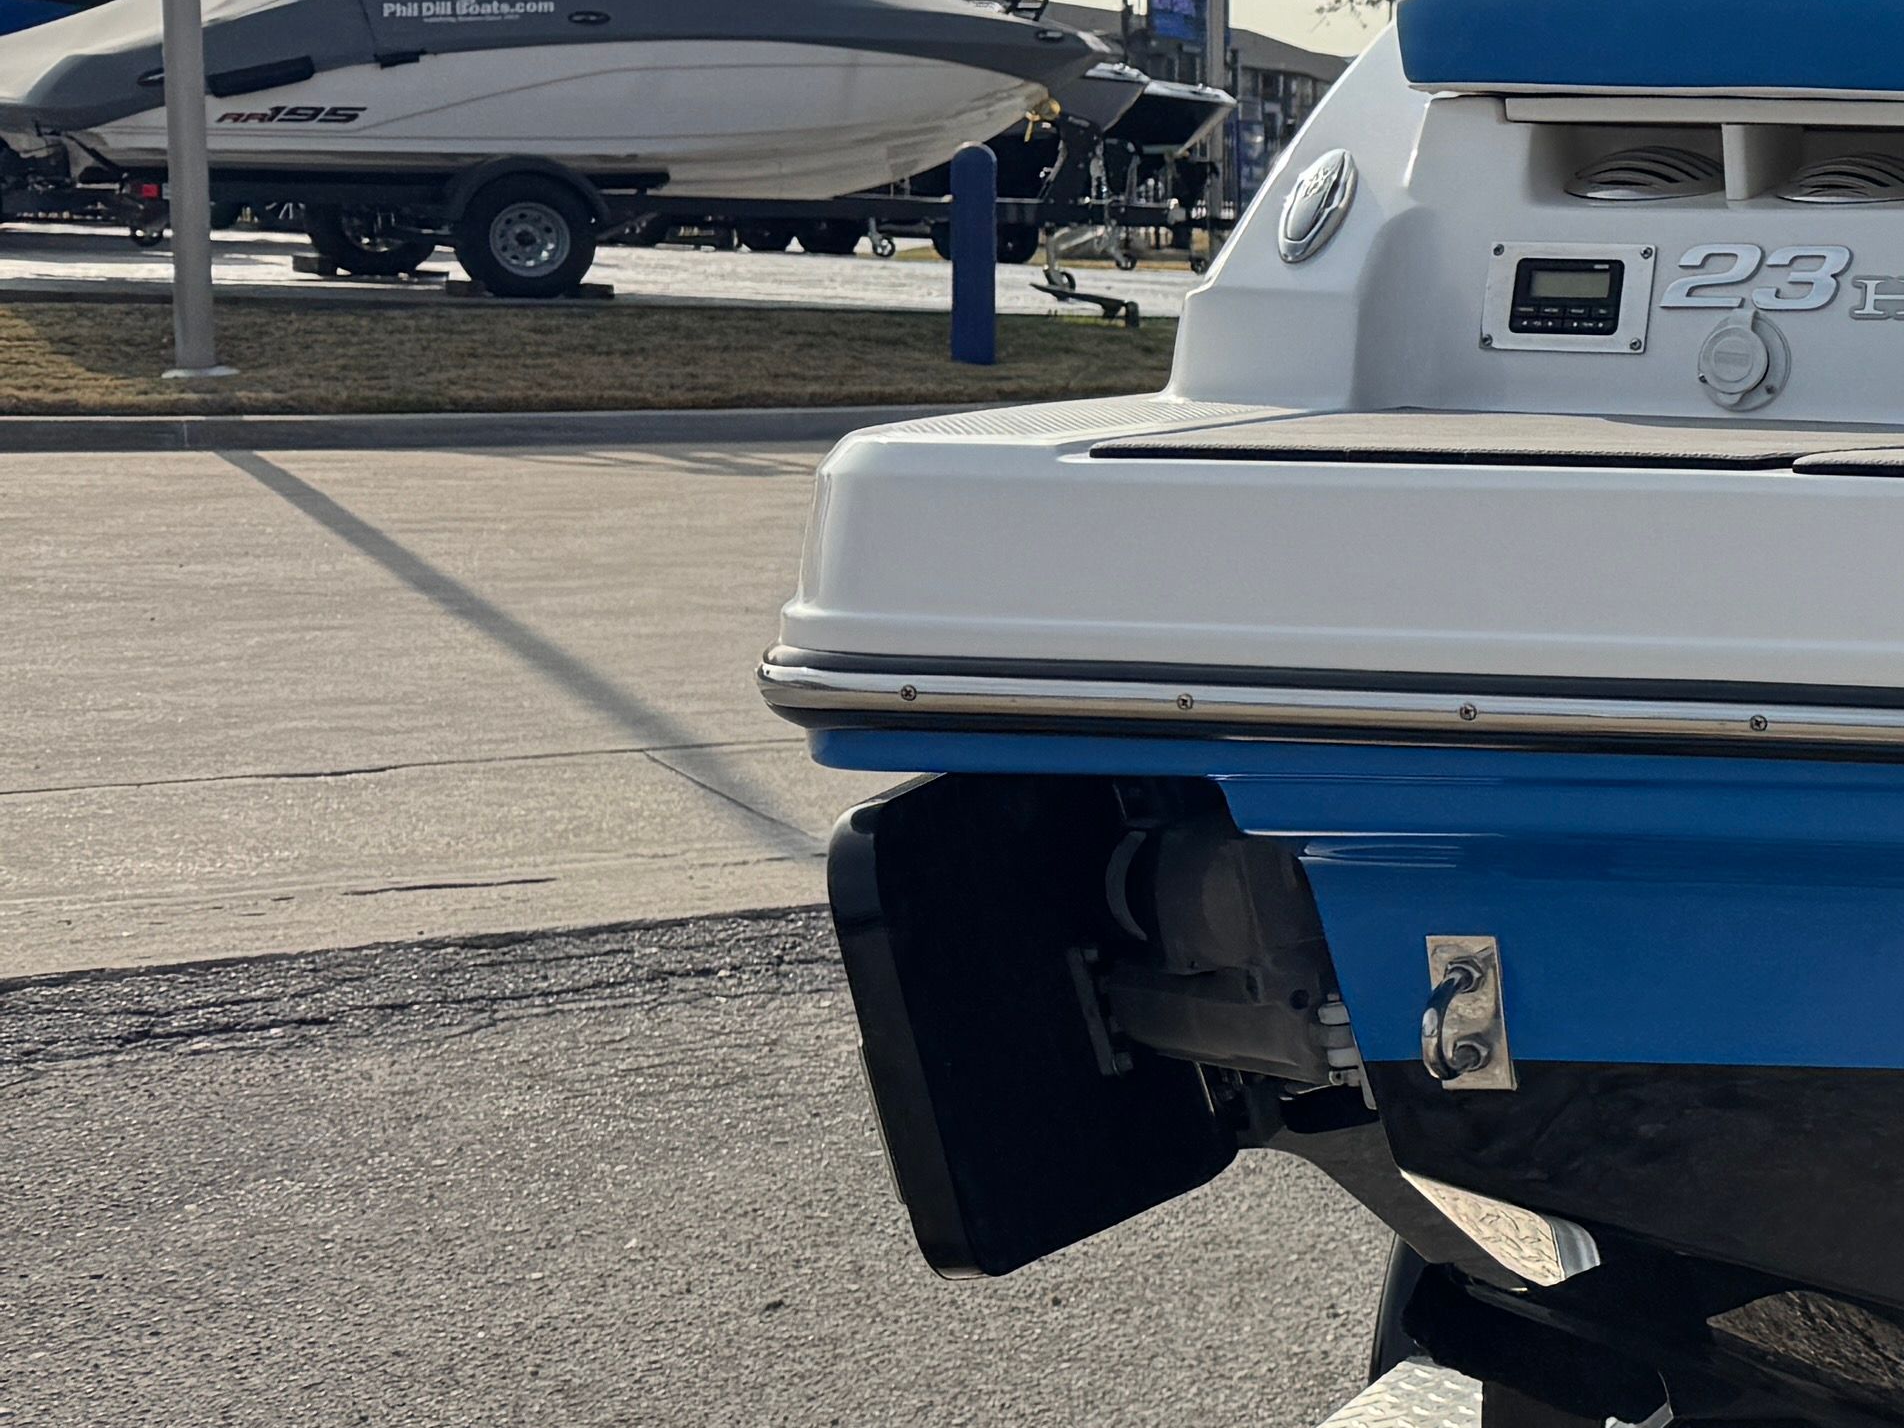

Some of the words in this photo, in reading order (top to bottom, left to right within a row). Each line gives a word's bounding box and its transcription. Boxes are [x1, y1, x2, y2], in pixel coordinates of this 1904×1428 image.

[382, 2, 419, 17] Phil
[422, 0, 452, 16] Dill
[1660, 243, 1854, 311] 23
